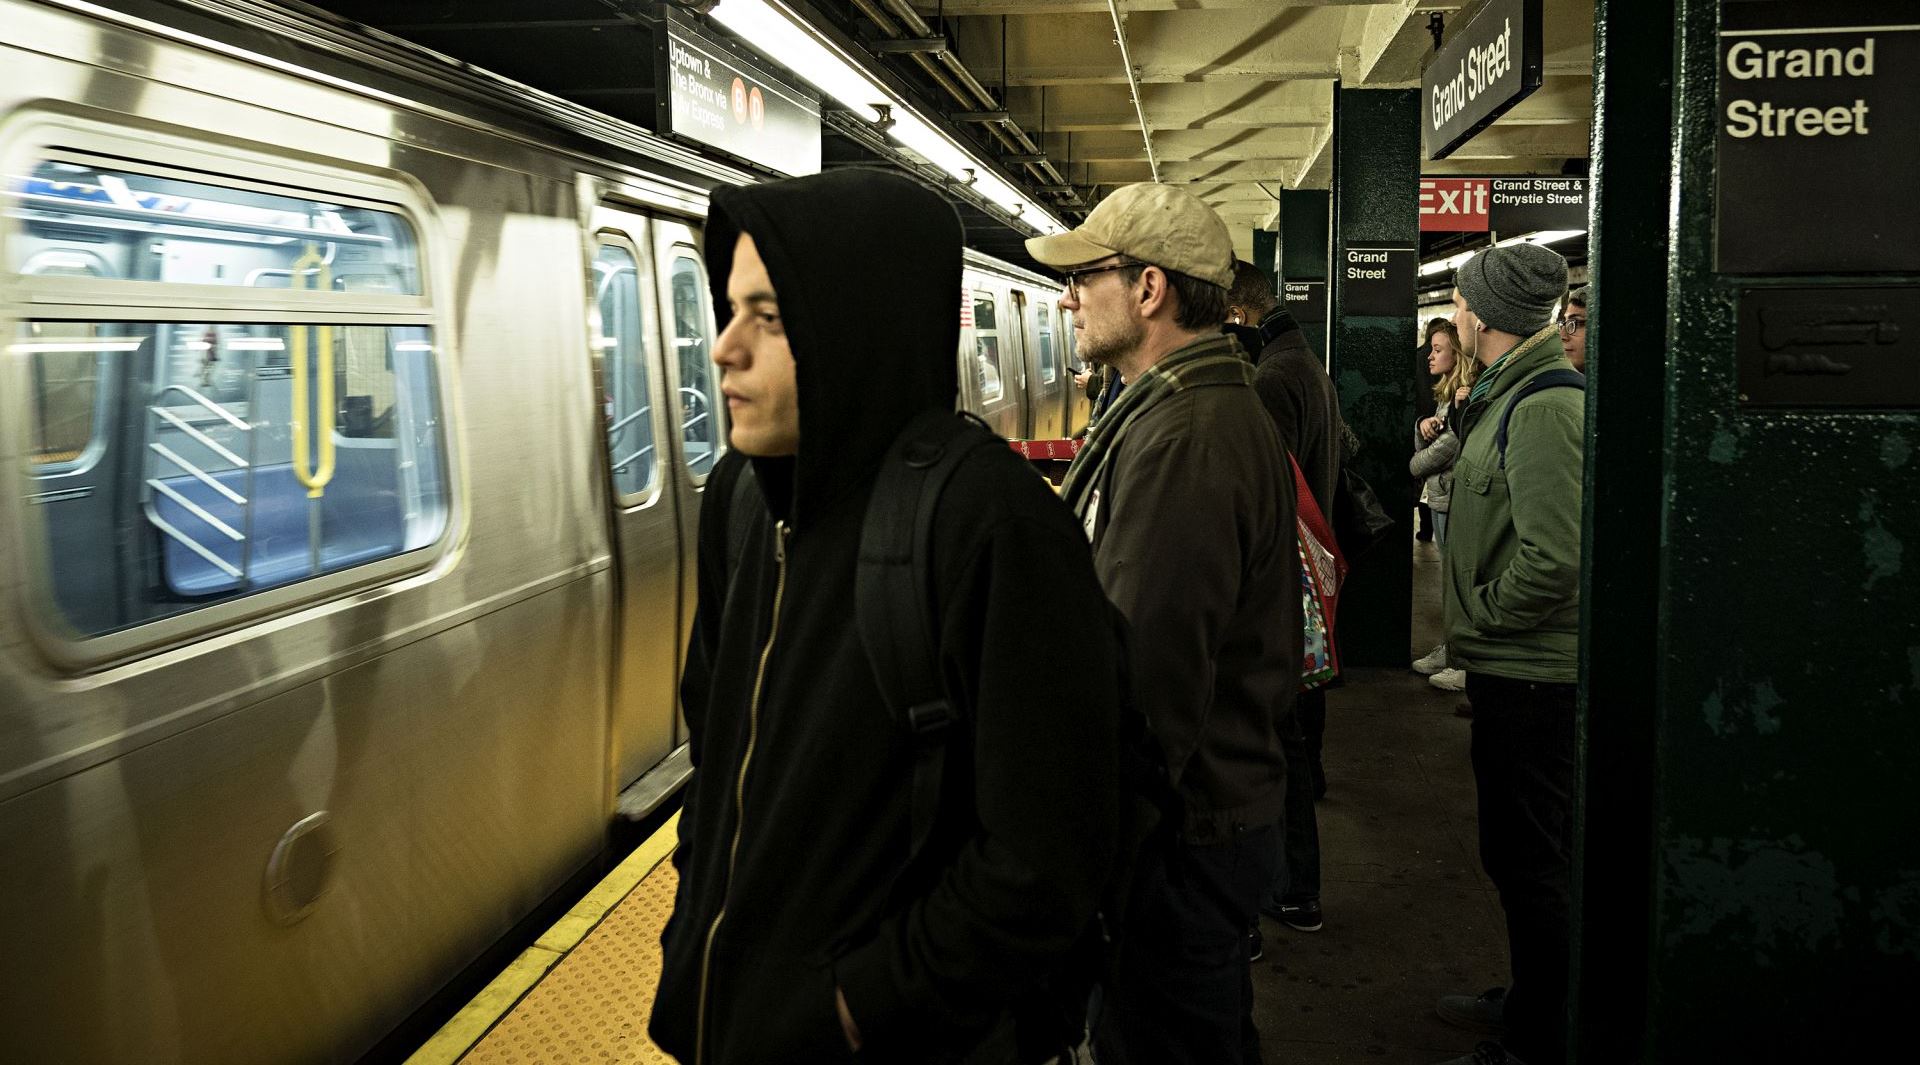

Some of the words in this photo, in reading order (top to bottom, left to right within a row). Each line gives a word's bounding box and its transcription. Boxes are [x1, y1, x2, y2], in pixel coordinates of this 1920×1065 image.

[669, 38, 702, 75] Uptown
[704, 59, 711, 79] &
[1432, 59, 1465, 131] Grand
[1467, 17, 1511, 101] Street
[1726, 38, 1875, 80] Grand
[670, 63, 687, 91] The
[689, 73, 714, 103] Bronx
[715, 88, 727, 109] via
[692, 99, 725, 131] Express
[735, 87, 743, 113] B
[752, 95, 761, 121] D
[1725, 99, 1869, 139] Street
[1419, 181, 1488, 215] Exit
[1492, 193, 1543, 206] Chrystie
[1546, 193, 1583, 204] Street
[1493, 180, 1530, 191] Grand
[1533, 180, 1570, 191] Street
[1573, 180, 1582, 191] &
[1347, 251, 1388, 263] Grand
[1347, 267, 1386, 279] Street
[1285, 293, 1308, 301] Street
